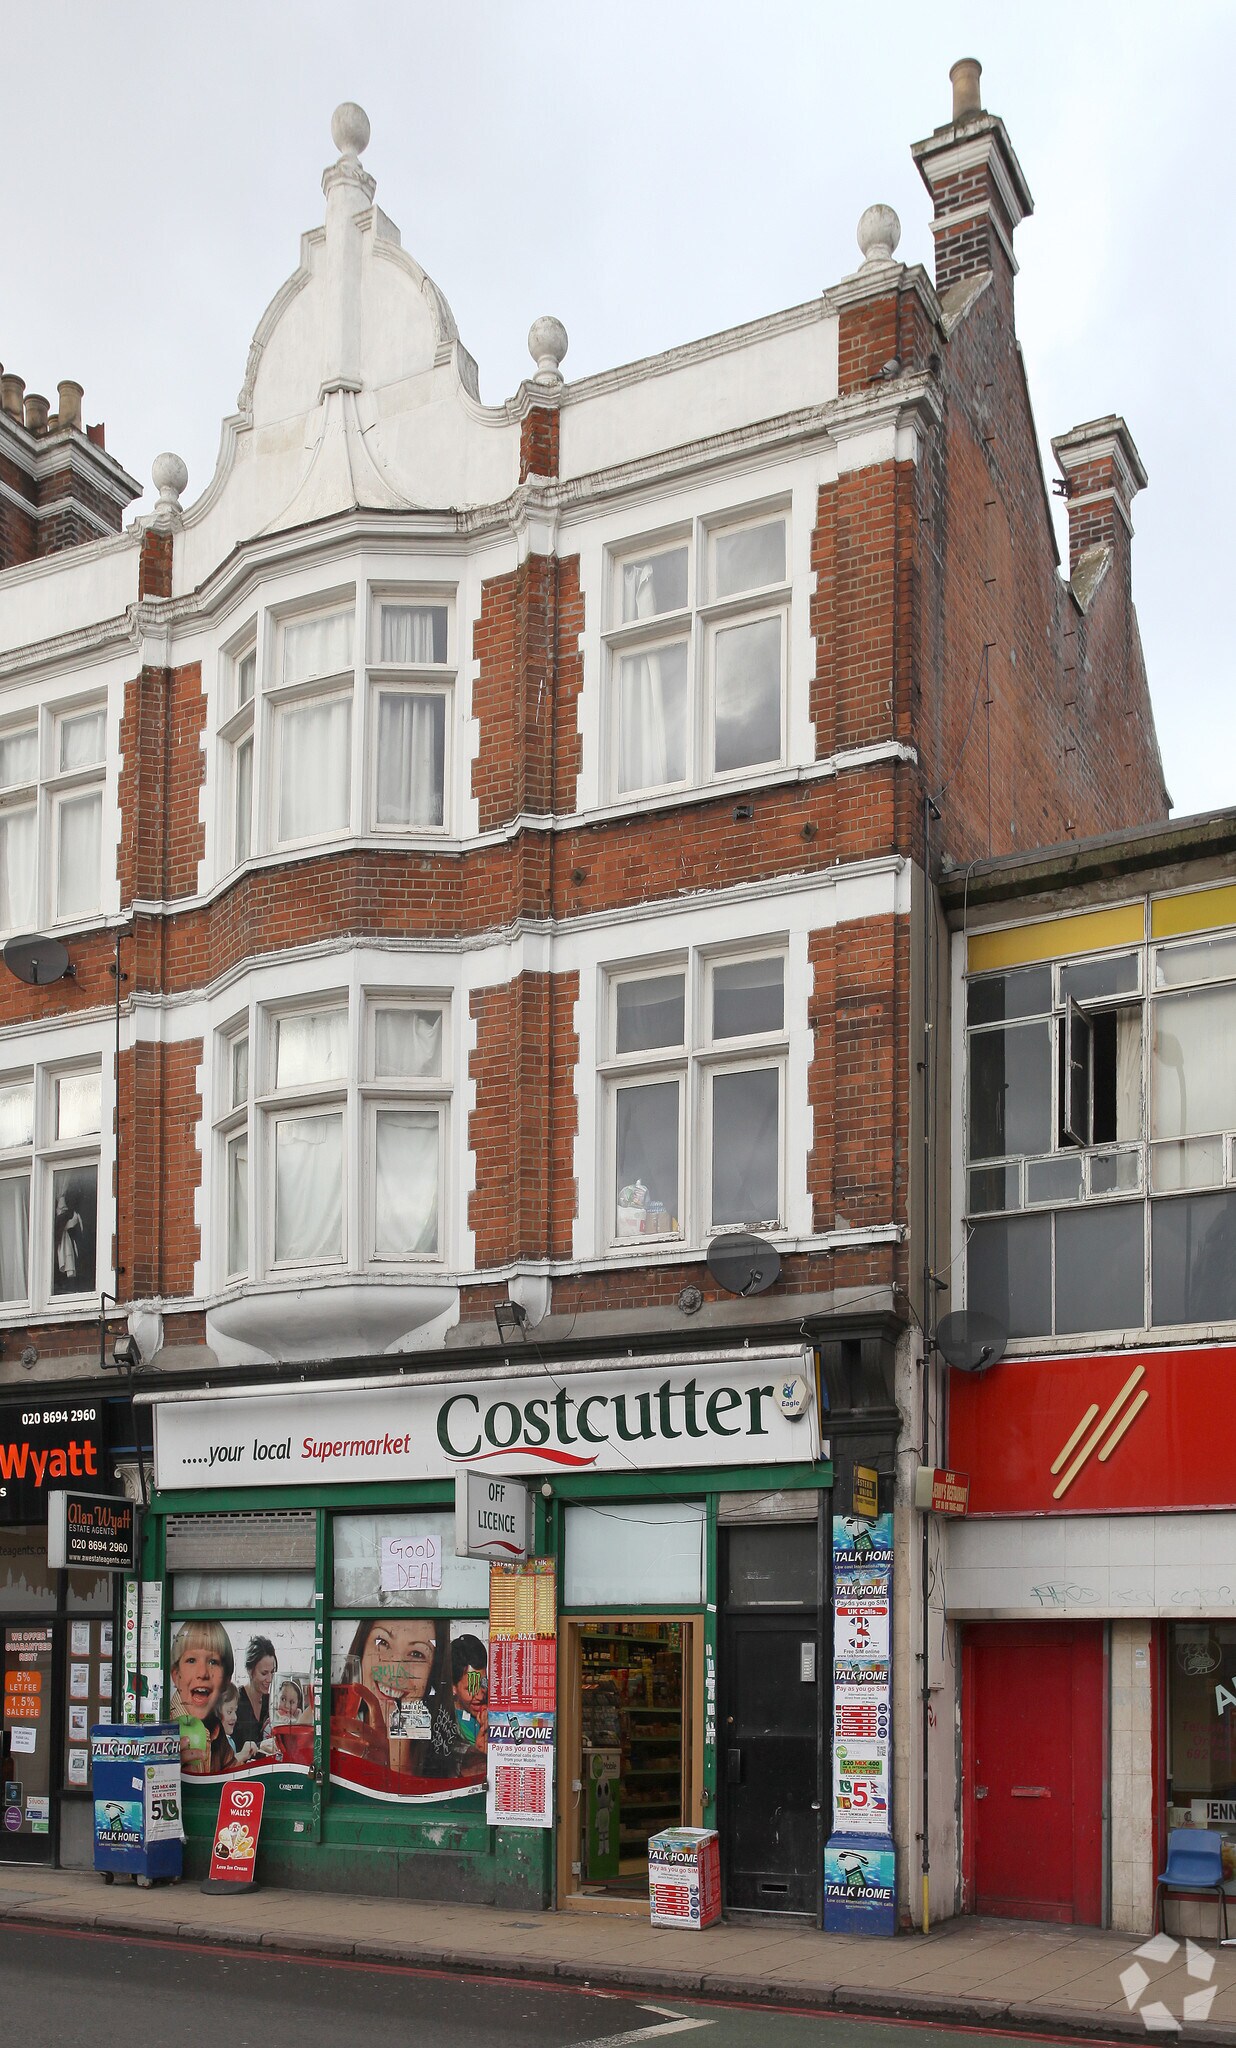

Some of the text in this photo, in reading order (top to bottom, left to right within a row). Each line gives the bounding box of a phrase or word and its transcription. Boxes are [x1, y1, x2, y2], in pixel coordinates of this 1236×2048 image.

[781, 1399, 800, 1408] Eagle
[22, 1408, 96, 1425] 020 8694 2960
[437, 1378, 775, 1457] Costcutter
[252, 1437, 291, 1461] local
[301, 1433, 411, 1463] Supermarket
[0, 1440, 97, 1487] Wyatt
[488, 1482, 506, 1503] OFF
[94, 1506, 131, 1535] Wyatt
[478, 1511, 515, 1534] LICENCE
[69, 1524, 115, 1536] ESTATE AGENTS
[72, 1538, 128, 1553] 020 8694 2960
[390, 1538, 435, 1559] GOOD
[836, 1552, 862, 1562] TALK
[398, 1562, 441, 1590] DEAL
[836, 1585, 888, 1595] TALK HOME
[11, 1633, 22, 1641] WE
[848, 1617, 871, 1649] 3
[5, 1642, 52, 1652] GUARANTEED
[19, 1653, 38, 1662] RENT
[17, 1672, 30, 1682] 5%
[836, 1671, 888, 1680] TALK HOME
[12, 1697, 35, 1707] 1.5%
[7, 1708, 24, 1716] SALE
[489, 1726, 552, 1739] TALK HOME
[92, 1744, 145, 1756] TALK HOME
[144, 1742, 169, 1755] TALK
[492, 1744, 504, 1752] Pay
[514, 1746, 526, 1754] you
[852, 1783, 868, 1808] 5
[151, 1800, 162, 1820] 5
[230, 1809, 252, 1817] WALL'S
[99, 1832, 140, 1842] TALK HOME
[649, 1850, 698, 1863] TALK HOME
[828, 1886, 891, 1899] TALK HOME
